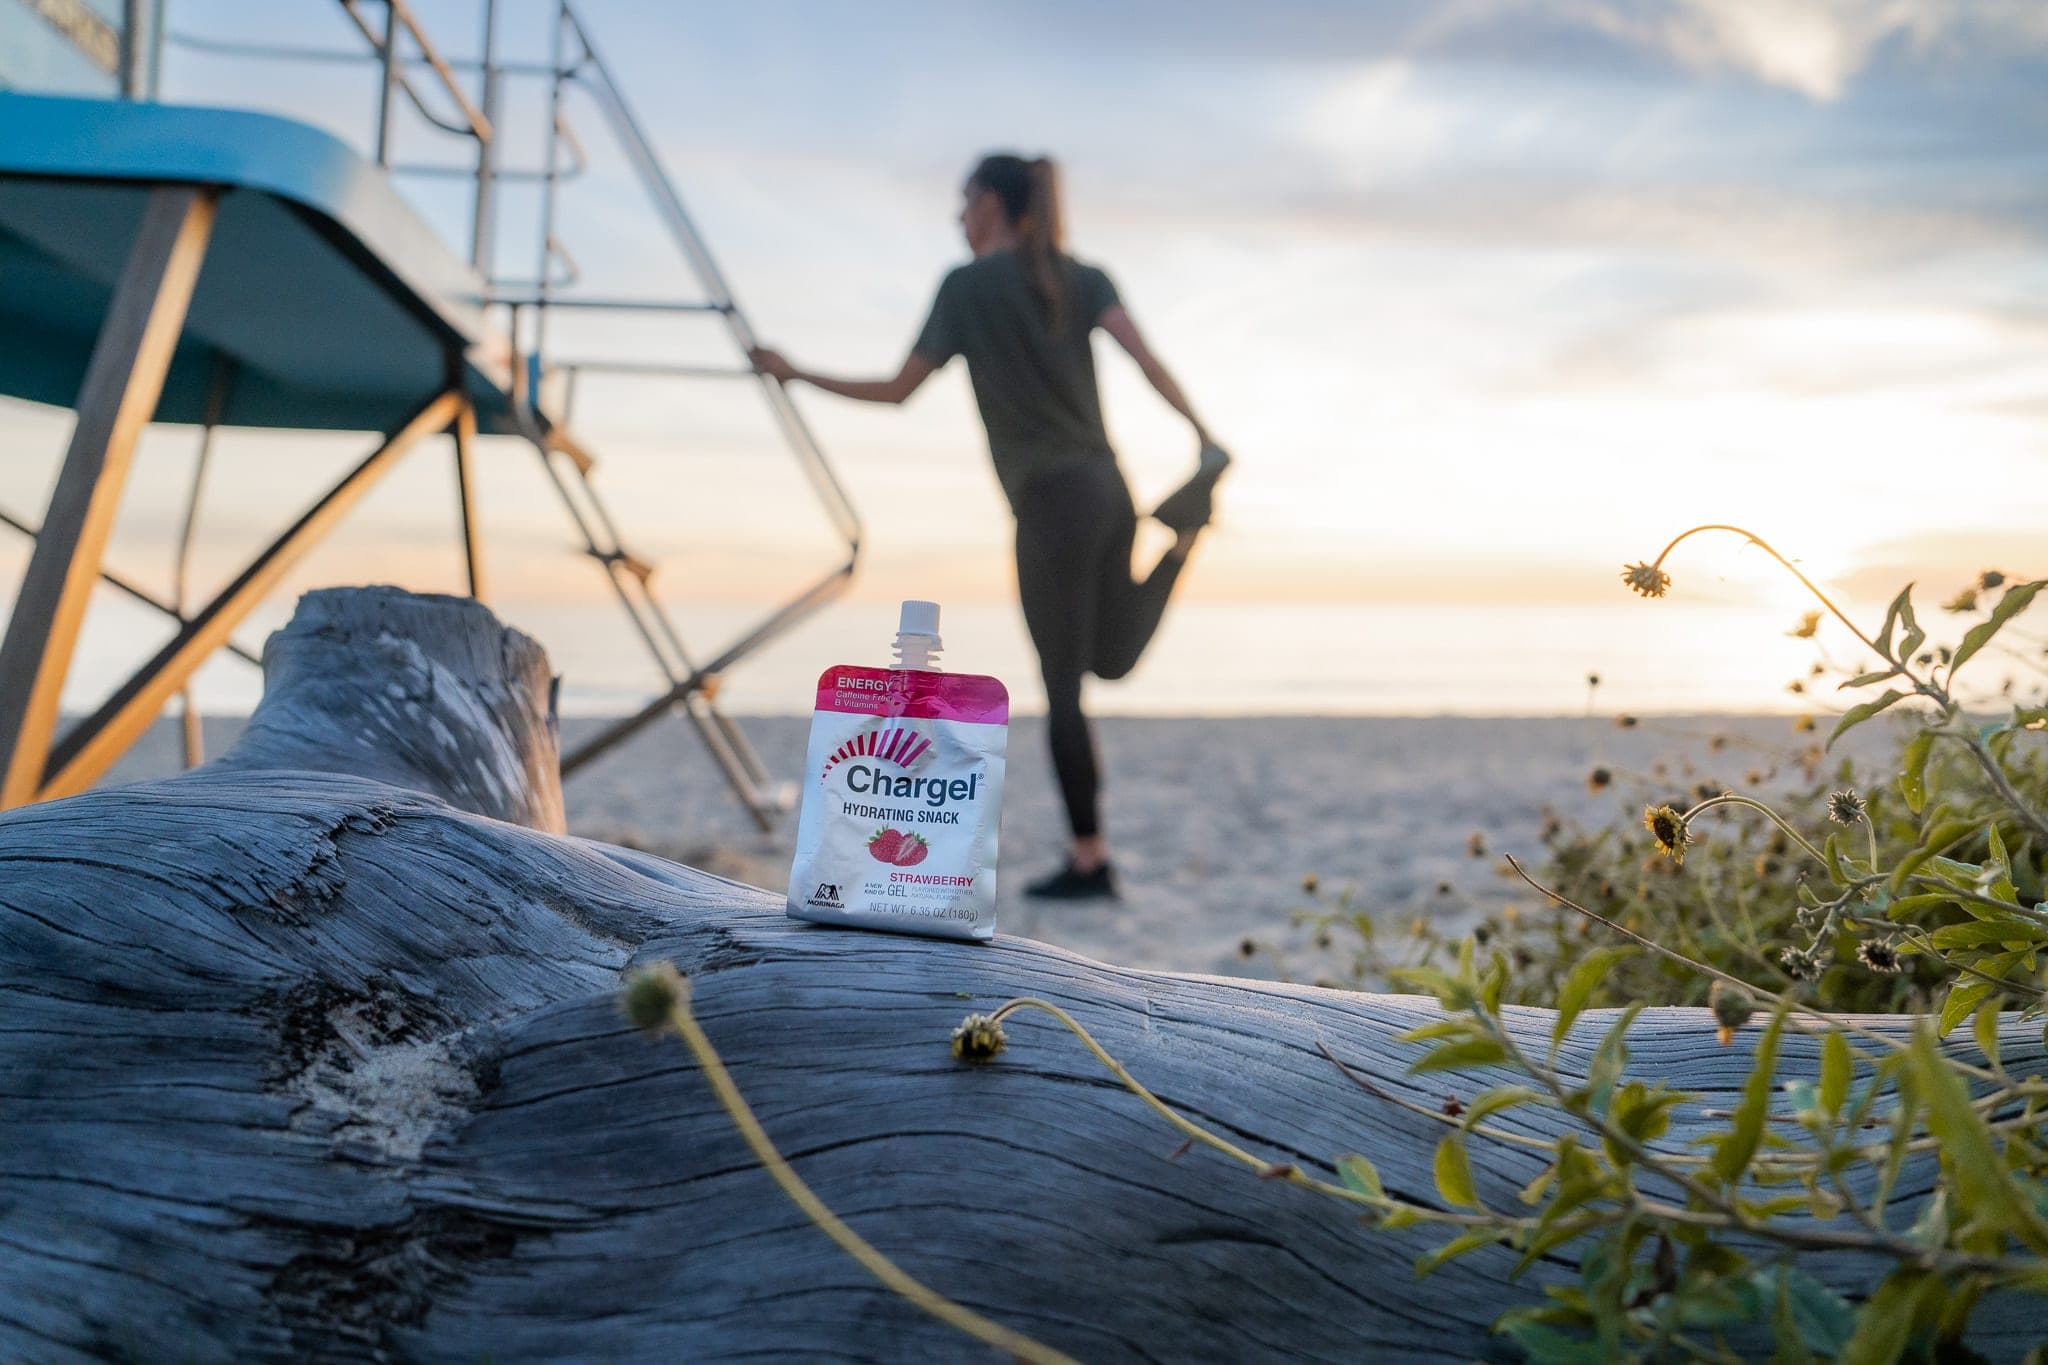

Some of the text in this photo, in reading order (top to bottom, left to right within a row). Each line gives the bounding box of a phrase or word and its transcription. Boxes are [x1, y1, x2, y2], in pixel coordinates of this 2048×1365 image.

[838, 677, 893, 691] ENERGY
[835, 690, 870, 700] Caffeine
[834, 698, 879, 709] B Vitamins
[847, 765, 976, 807] Chargel
[843, 801, 960, 825] HYDRATING SNACK
[890, 873, 973, 887] STRAWBERRY
[887, 884, 908, 898] GEL
[807, 899, 845, 909] MORINAGA
[869, 902, 888, 913] NET
[910, 905, 931, 917] 6.35
[933, 908, 946, 918] OZ
[948, 908, 979, 922] (180g)
